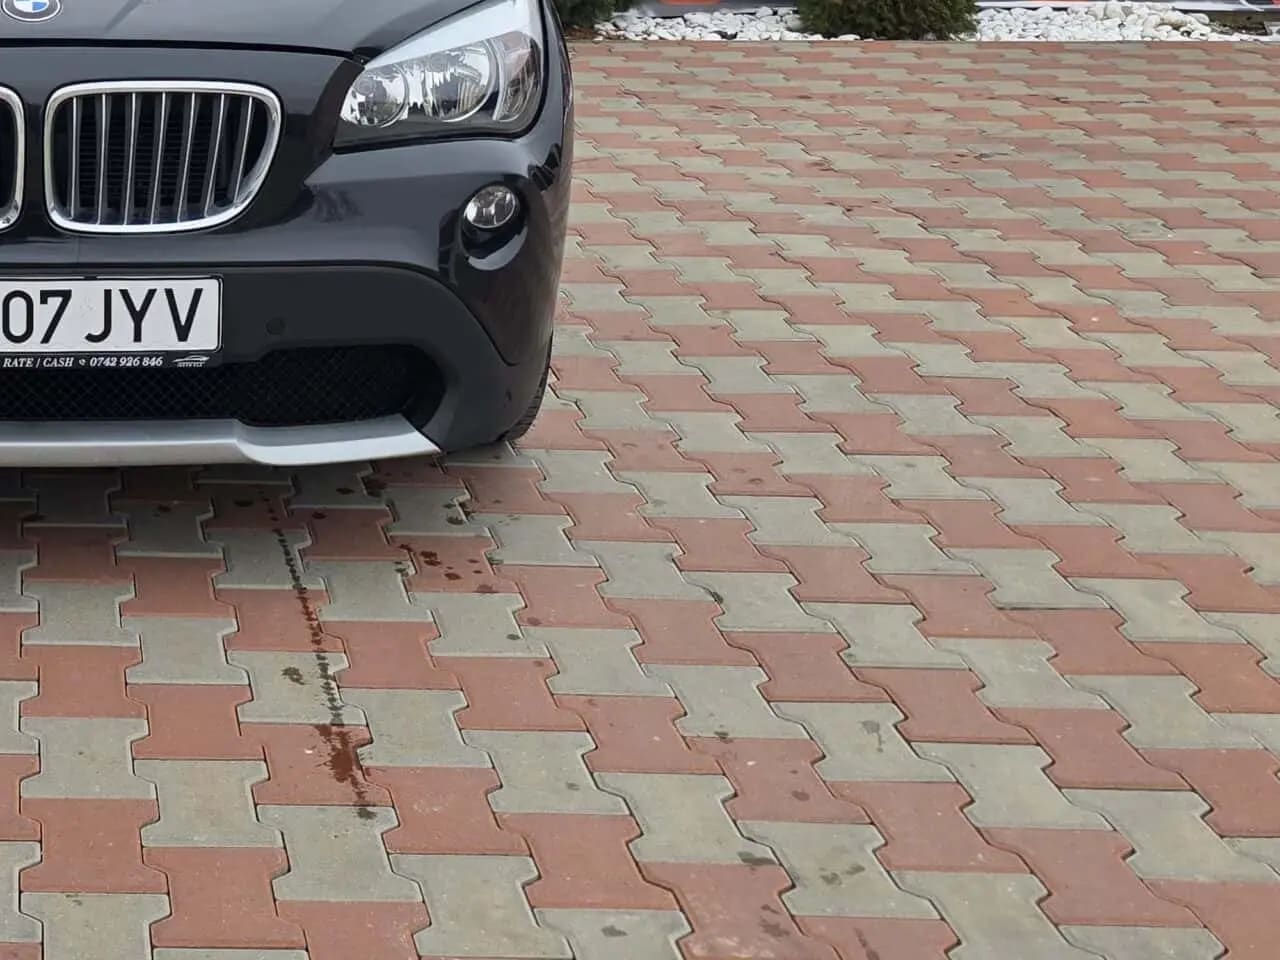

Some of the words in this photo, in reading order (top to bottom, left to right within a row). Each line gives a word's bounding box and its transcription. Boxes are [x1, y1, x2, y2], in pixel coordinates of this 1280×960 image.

[1, 288, 73, 345] 07
[84, 287, 205, 343] JYV
[3, 357, 34, 369] RATE
[43, 356, 74, 368] CASH
[89, 356, 117, 368] 0742
